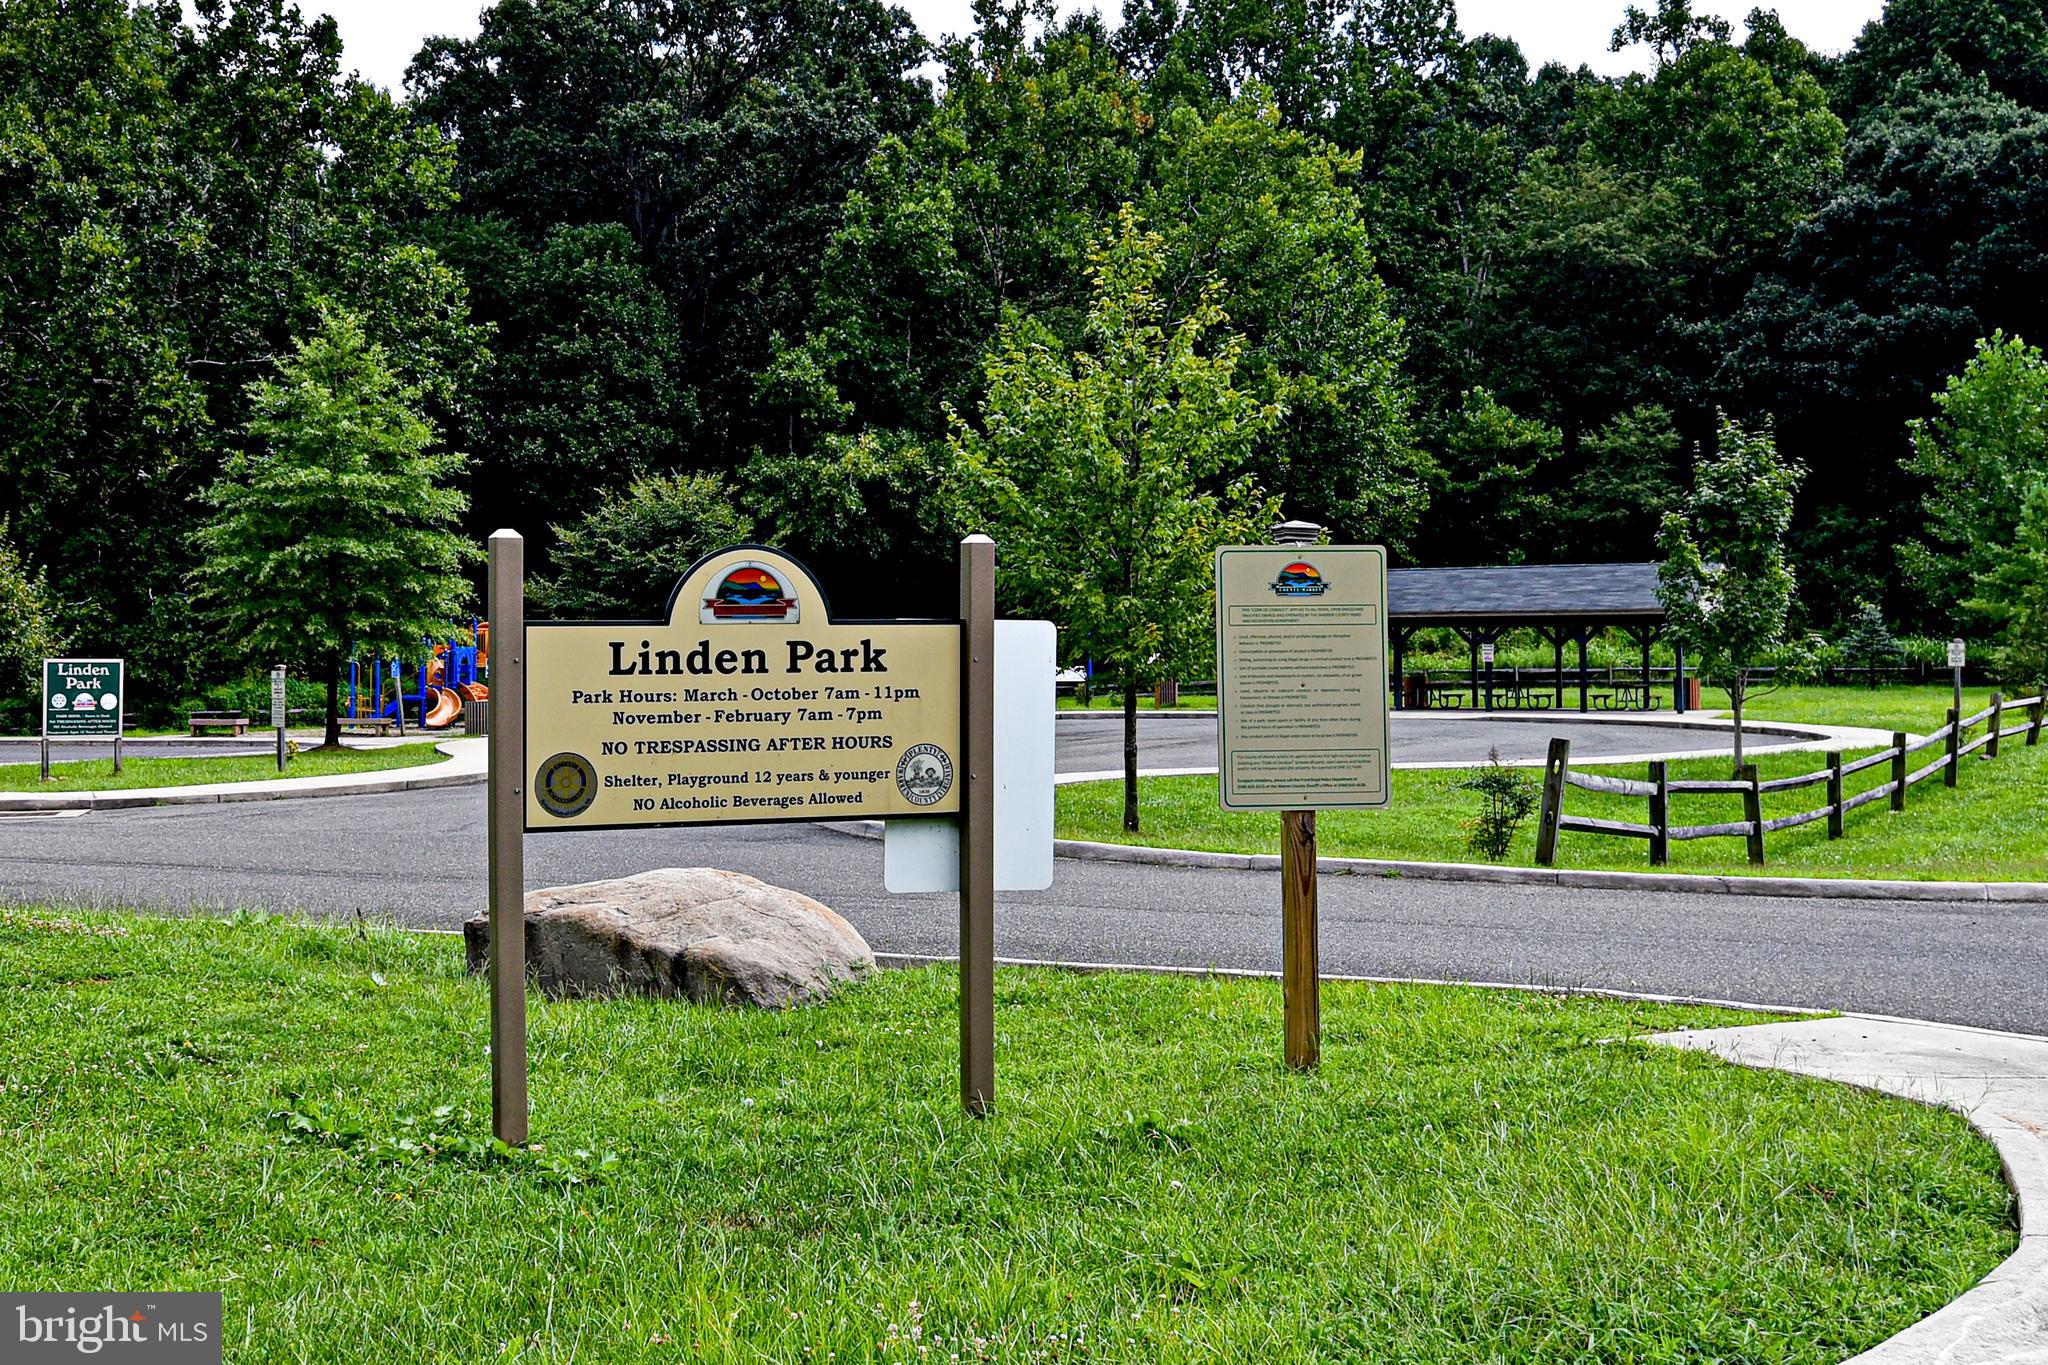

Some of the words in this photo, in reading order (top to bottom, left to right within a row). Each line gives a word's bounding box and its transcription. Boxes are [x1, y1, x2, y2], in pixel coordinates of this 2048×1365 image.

[609, 639, 769, 676] Linden
[786, 638, 888, 674] Park
[57, 663, 110, 676] Linden
[66, 677, 102, 690] Park
[572, 690, 613, 704] Park
[619, 690, 677, 704] Hours:
[684, 688, 738, 703] March
[751, 687, 818, 702] October
[825, 687, 861, 700] 7am
[874, 686, 921, 703] 11pm
[613, 709, 701, 725] November
[714, 708, 791, 726] February
[797, 707, 834, 722] 7am
[846, 707, 883, 724] 7pm
[602, 742, 629, 756] NO
[634, 739, 762, 755] TRESPASSING
[766, 737, 827, 752] AFTER
[832, 735, 893, 750] HOURS
[604, 774, 663, 793] Shelter,
[668, 770, 749, 789] Playground
[755, 770, 772, 784] 12
[776, 773, 815, 788] years
[819, 769, 834, 783] &
[839, 766, 891, 785] younger
[632, 798, 656, 811] NO
[660, 795, 727, 810] Alcoholic
[733, 795, 803, 813] Beverages
[808, 792, 864, 806] Allowed
